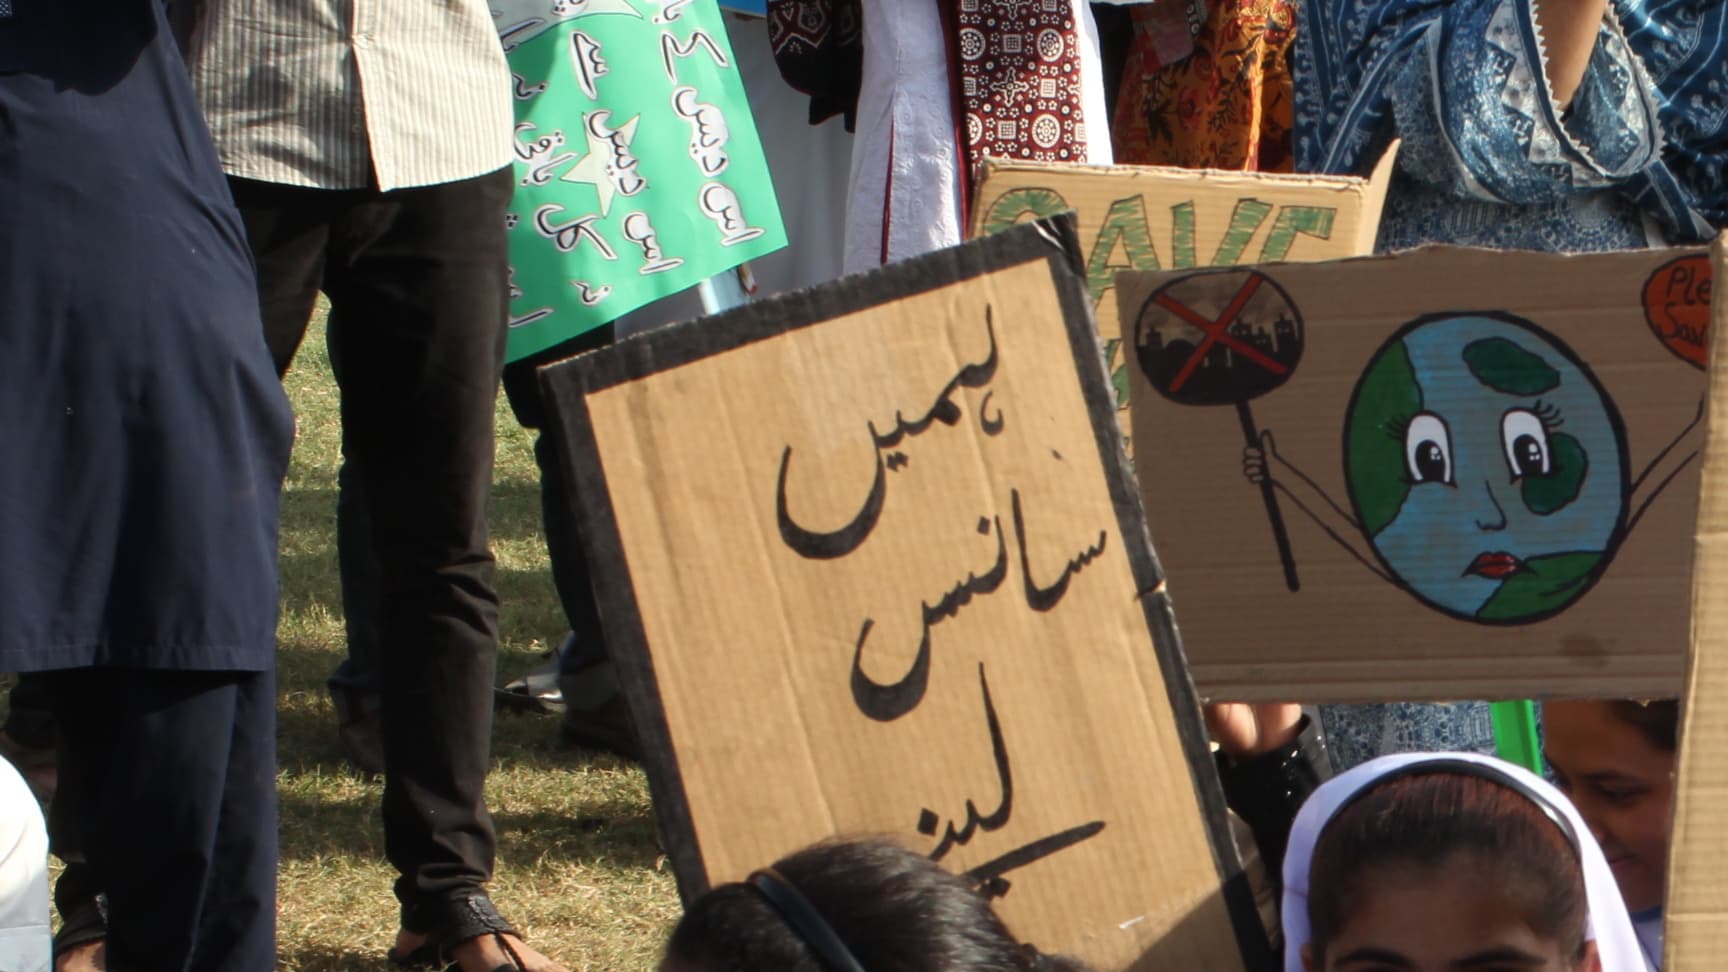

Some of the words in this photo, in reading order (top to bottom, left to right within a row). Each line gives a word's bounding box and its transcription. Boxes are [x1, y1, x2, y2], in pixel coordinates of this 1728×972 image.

[572, 32, 608, 99] سے
[661, 31, 728, 83] کے
[624, 213, 682, 273] اس
[702, 186, 762, 244] اس
[1665, 265, 1711, 306] Ple
[775, 304, 1004, 560] ہمیں
[849, 489, 1107, 721] سانس
